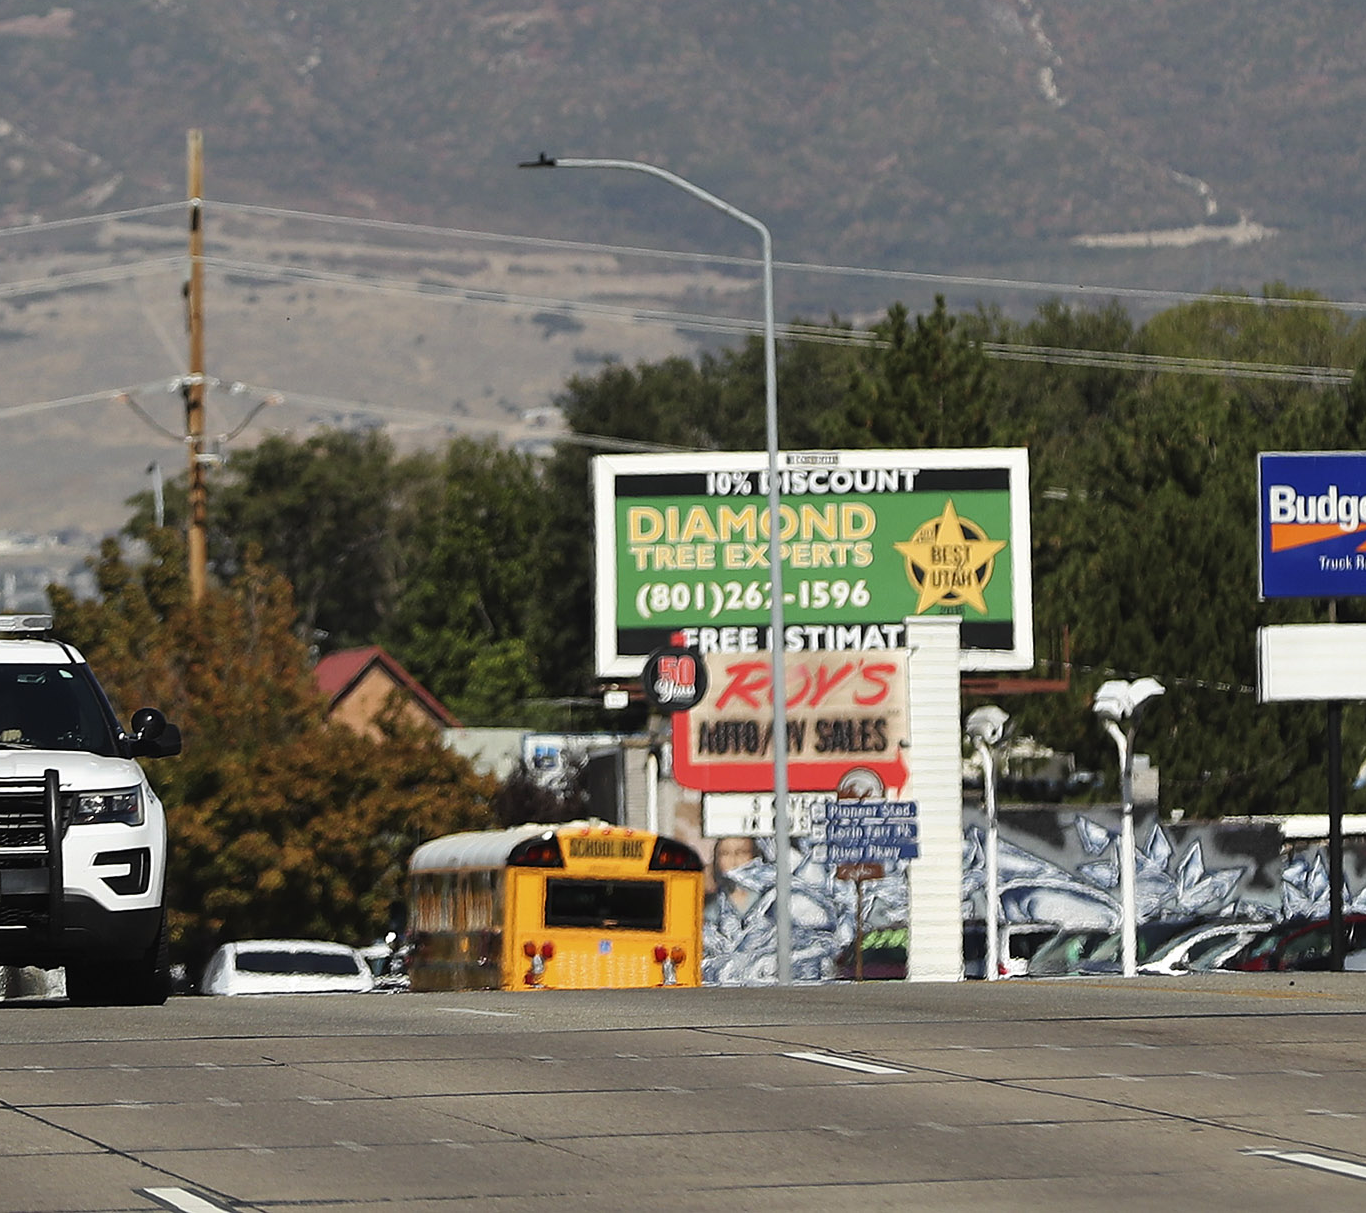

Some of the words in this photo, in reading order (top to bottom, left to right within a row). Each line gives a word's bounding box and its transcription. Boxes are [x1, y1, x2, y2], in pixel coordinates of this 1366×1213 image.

[706, 471, 752, 496] 10%
[758, 468, 920, 496] DISCOUNT
[627, 502, 876, 543] DIAMOND
[629, 543, 716, 571] TREE
[931, 545, 972, 565] BEST
[1319, 554, 1353, 571] Truck
[931, 568, 972, 587] UTAH
[683, 626, 759, 653] FREE
[765, 623, 905, 654] STIMAT
[657, 655, 696, 686] 50
[715, 657, 897, 710] ROY'S
[697, 718, 807, 757] AUTO/V
[814, 717, 888, 753] SALES
[830, 804, 879, 819] Pioneer
[882, 803, 915, 817] Stad.
[569, 837, 614, 858] SCHOOL
[621, 838, 645, 860] BUS
[831, 844, 865, 859] River
[868, 844, 901, 860] Pkwy
